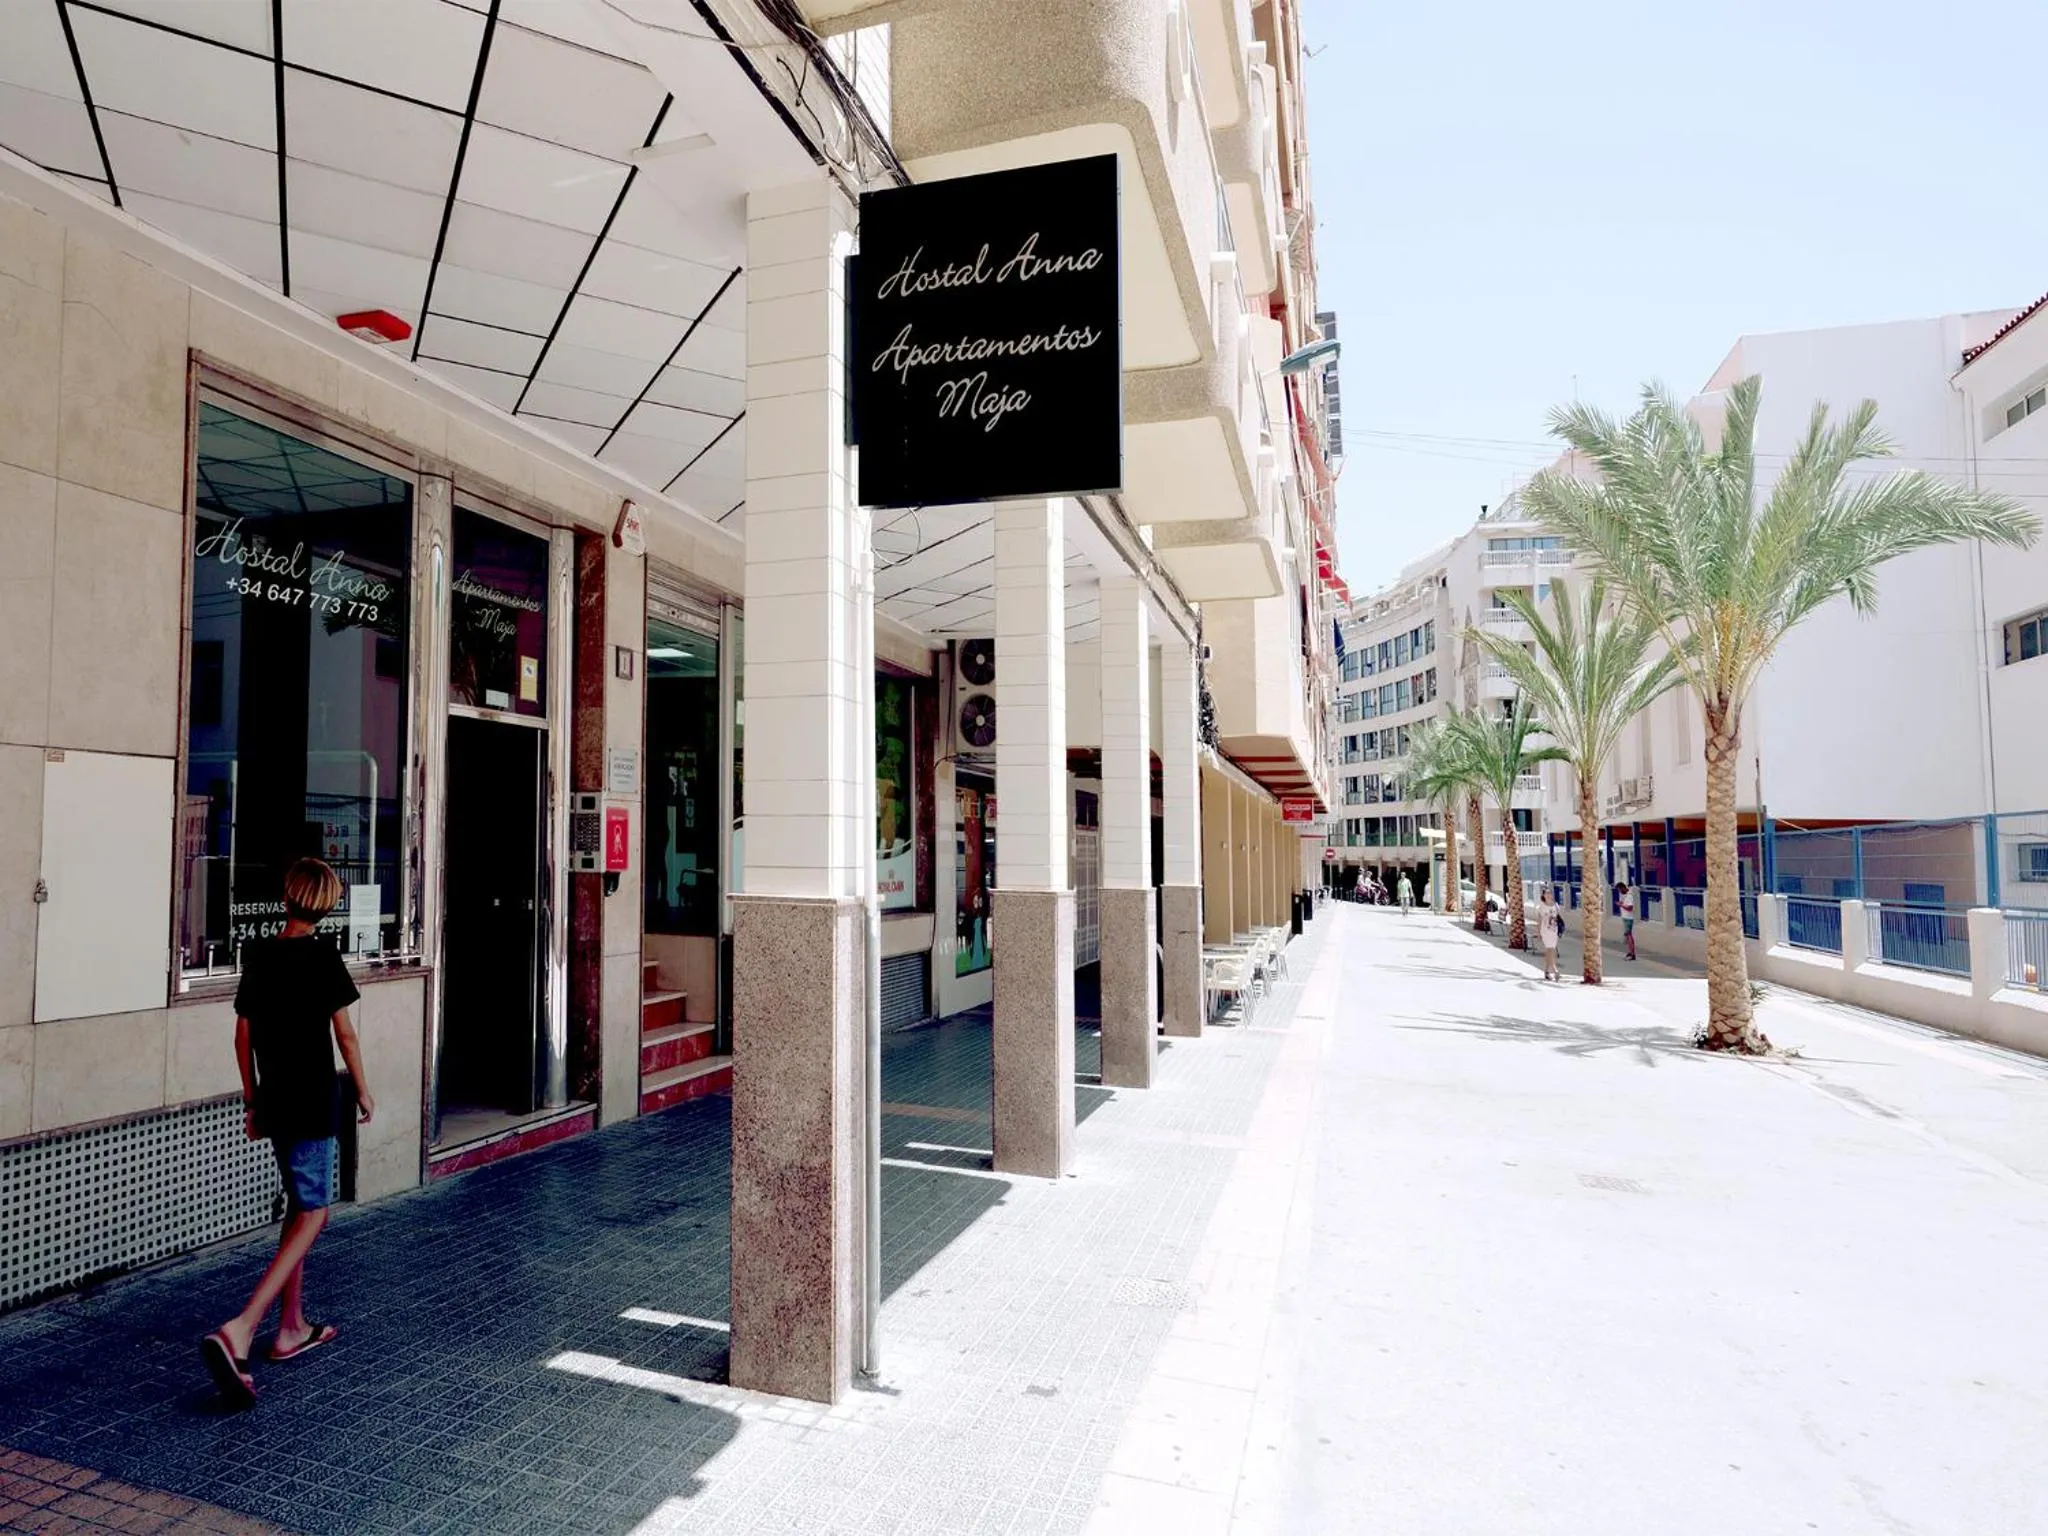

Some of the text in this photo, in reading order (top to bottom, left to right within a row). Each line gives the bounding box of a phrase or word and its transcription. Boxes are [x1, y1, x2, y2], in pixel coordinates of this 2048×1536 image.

[878, 232, 1103, 299] Hostal Anna
[871, 323, 1102, 385] Apartamentos
[936, 371, 1032, 432] Maja
[195, 516, 391, 601] Hostal Anna
[226, 577, 379, 622] +34 647 773 773
[451, 568, 543, 613] Apartamentos
[479, 608, 517, 642] Maja
[229, 922, 257, 940] +34
[260, 920, 288, 939] 647
[231, 901, 287, 916] RESERVAS
